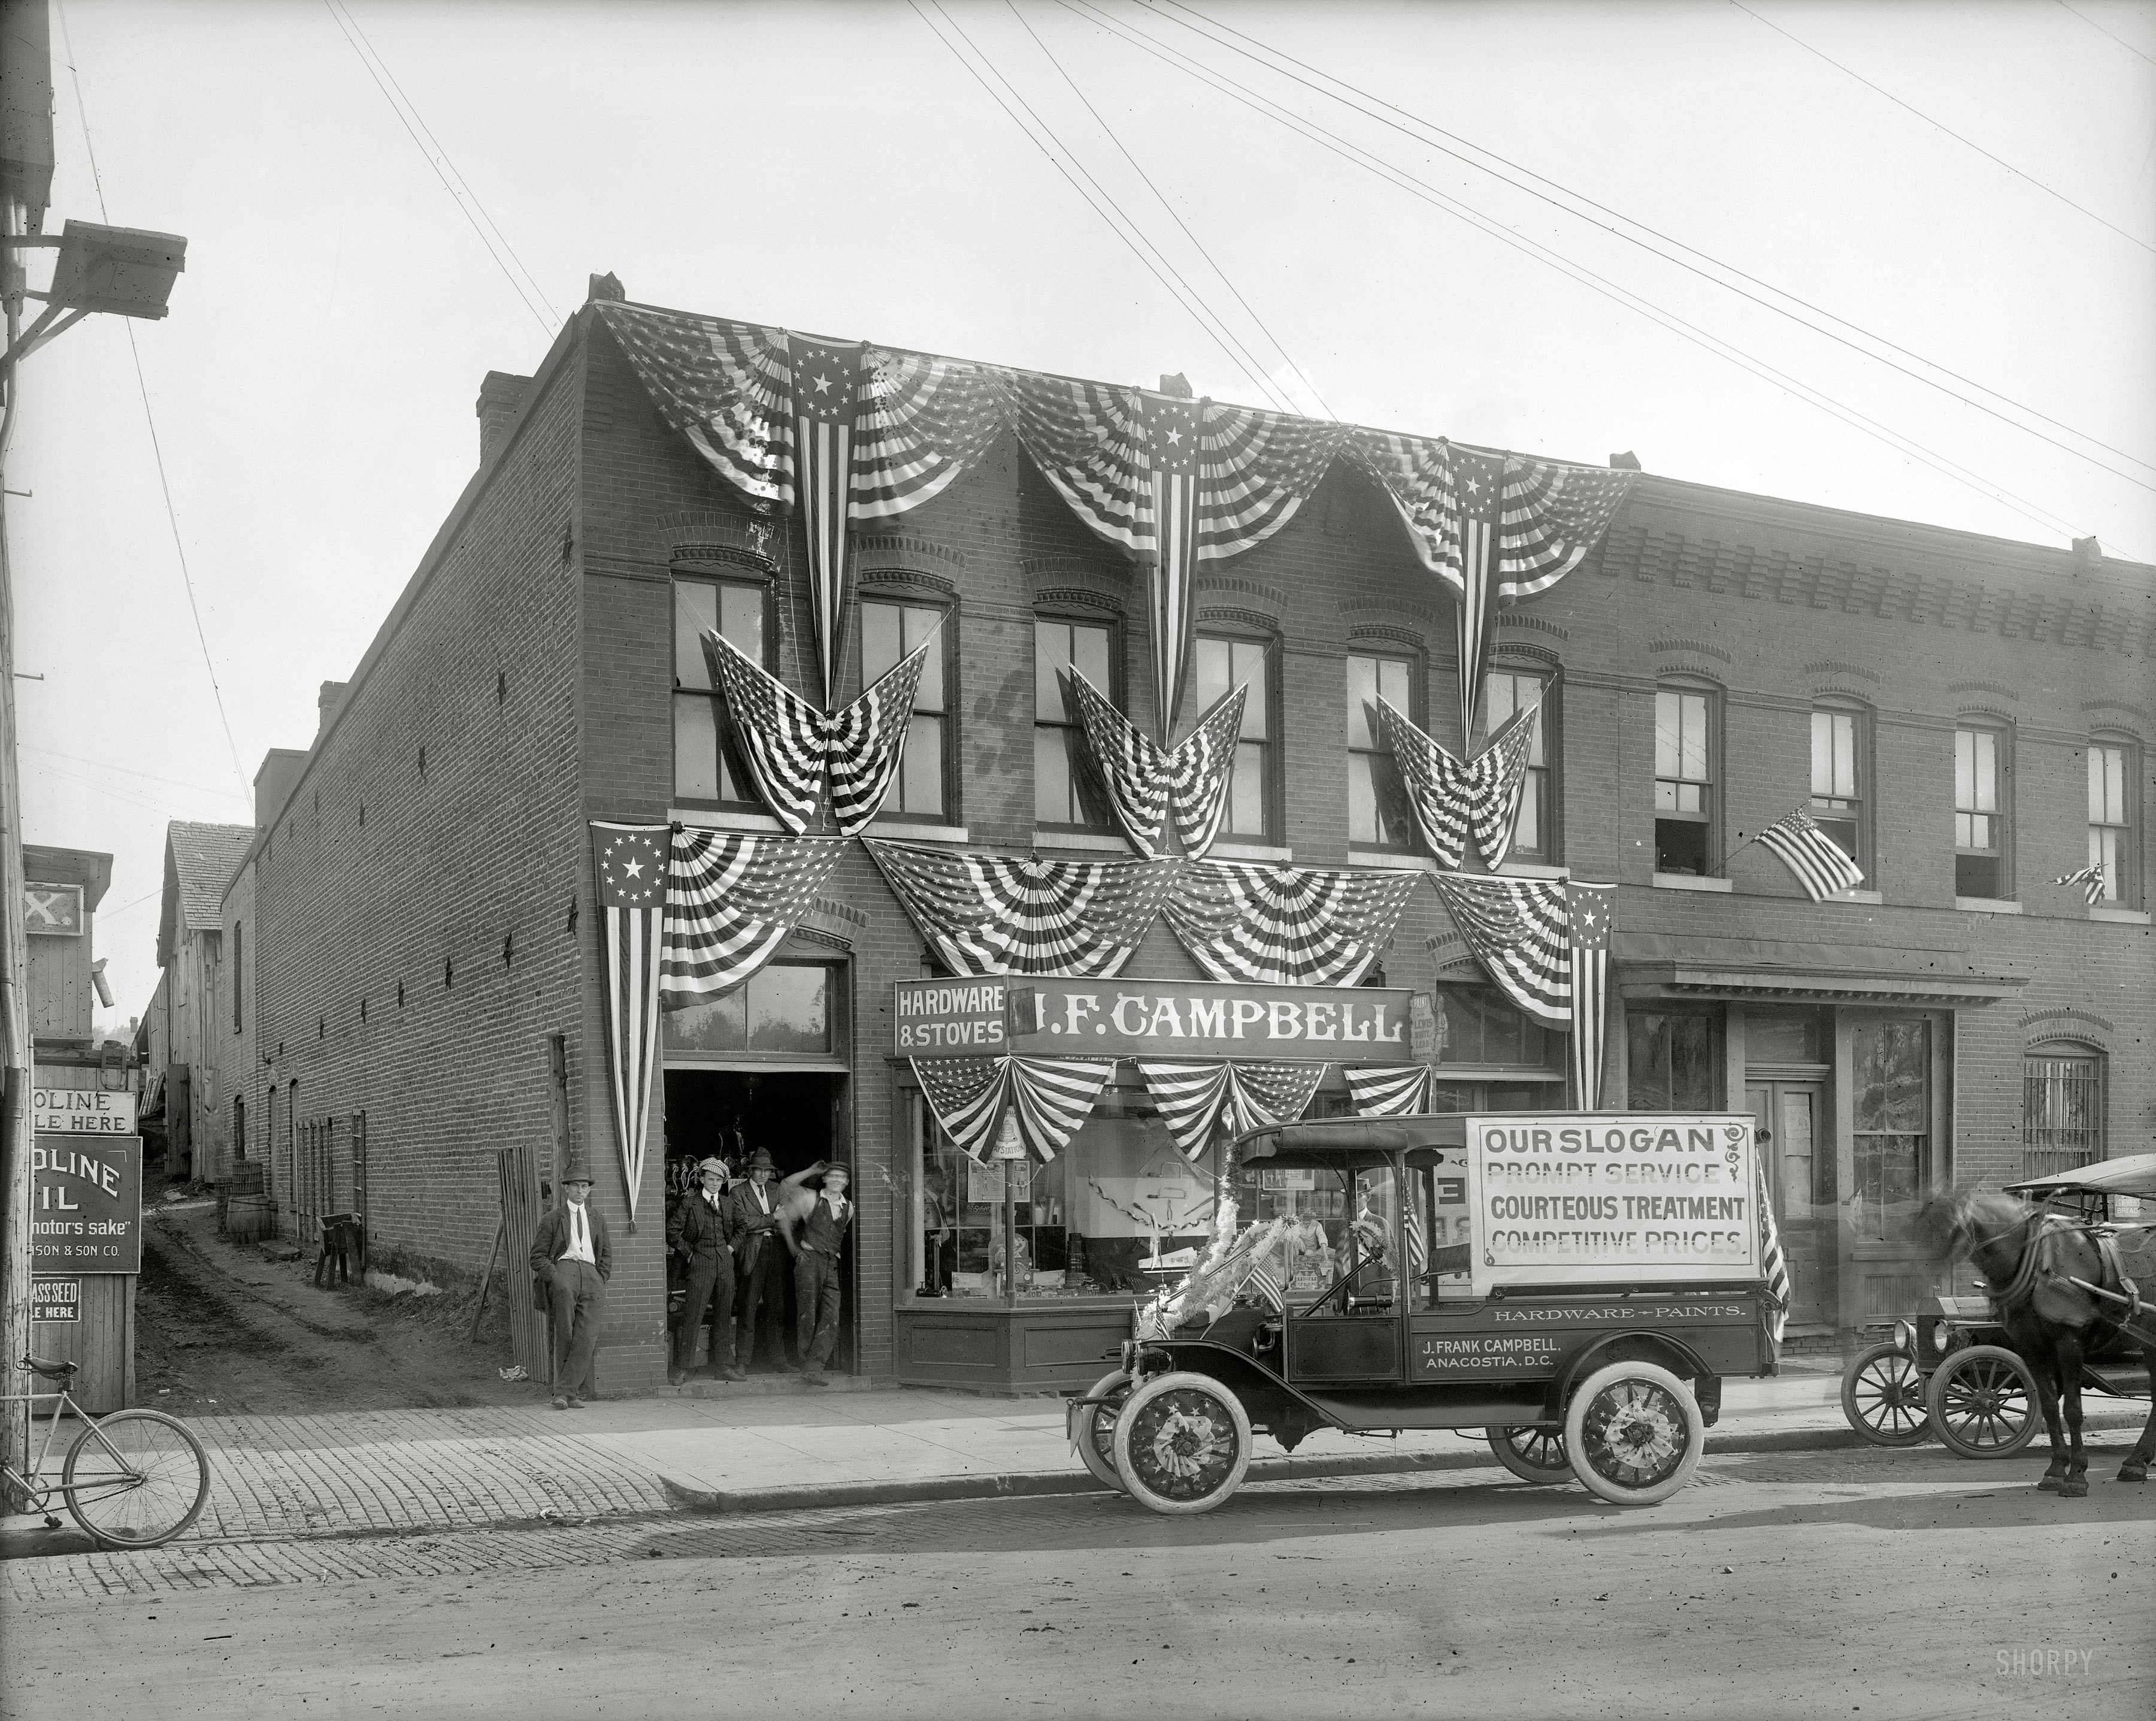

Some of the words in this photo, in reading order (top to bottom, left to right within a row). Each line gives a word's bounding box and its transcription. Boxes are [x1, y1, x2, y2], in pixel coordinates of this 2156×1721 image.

[900, 986, 1004, 1016] HARDWARE
[1414, 996, 1427, 1009] PAINT
[1110, 992, 1403, 1043] CAMPBELL
[1415, 1018, 1433, 1030] LEWIS
[71, 1116, 126, 1131] HERE
[1000, 1142, 1024, 1154] STATION
[1485, 1129, 1552, 1153] OUR
[1559, 1129, 1715, 1154] SLOGAN
[1487, 1162, 1597, 1185] PROMPT
[1604, 1163, 1720, 1185] SERVICE
[1491, 1196, 1618, 1220] COURTEOUS
[1622, 1196, 1745, 1220] TREATMENT
[1492, 1230, 1637, 1254] COMPETITIVE
[1645, 1231, 1742, 1254] PRICES
[64, 1245, 72, 1256] &
[75, 1245, 98, 1256] SON
[104, 1245, 120, 1256] CO.
[52, 1283, 77, 1303] SEED
[46, 1306, 74, 1318] HERE
[1495, 1308, 1635, 1321] HARDWARE
[1654, 1305, 1747, 1318] PAINTS.
[1422, 1341, 1435, 1354] J.
[1436, 1340, 1480, 1354] FRANK
[1426, 1356, 1522, 1368] ANACOSTIA,
[1525, 1354, 1554, 1366] D.C.
